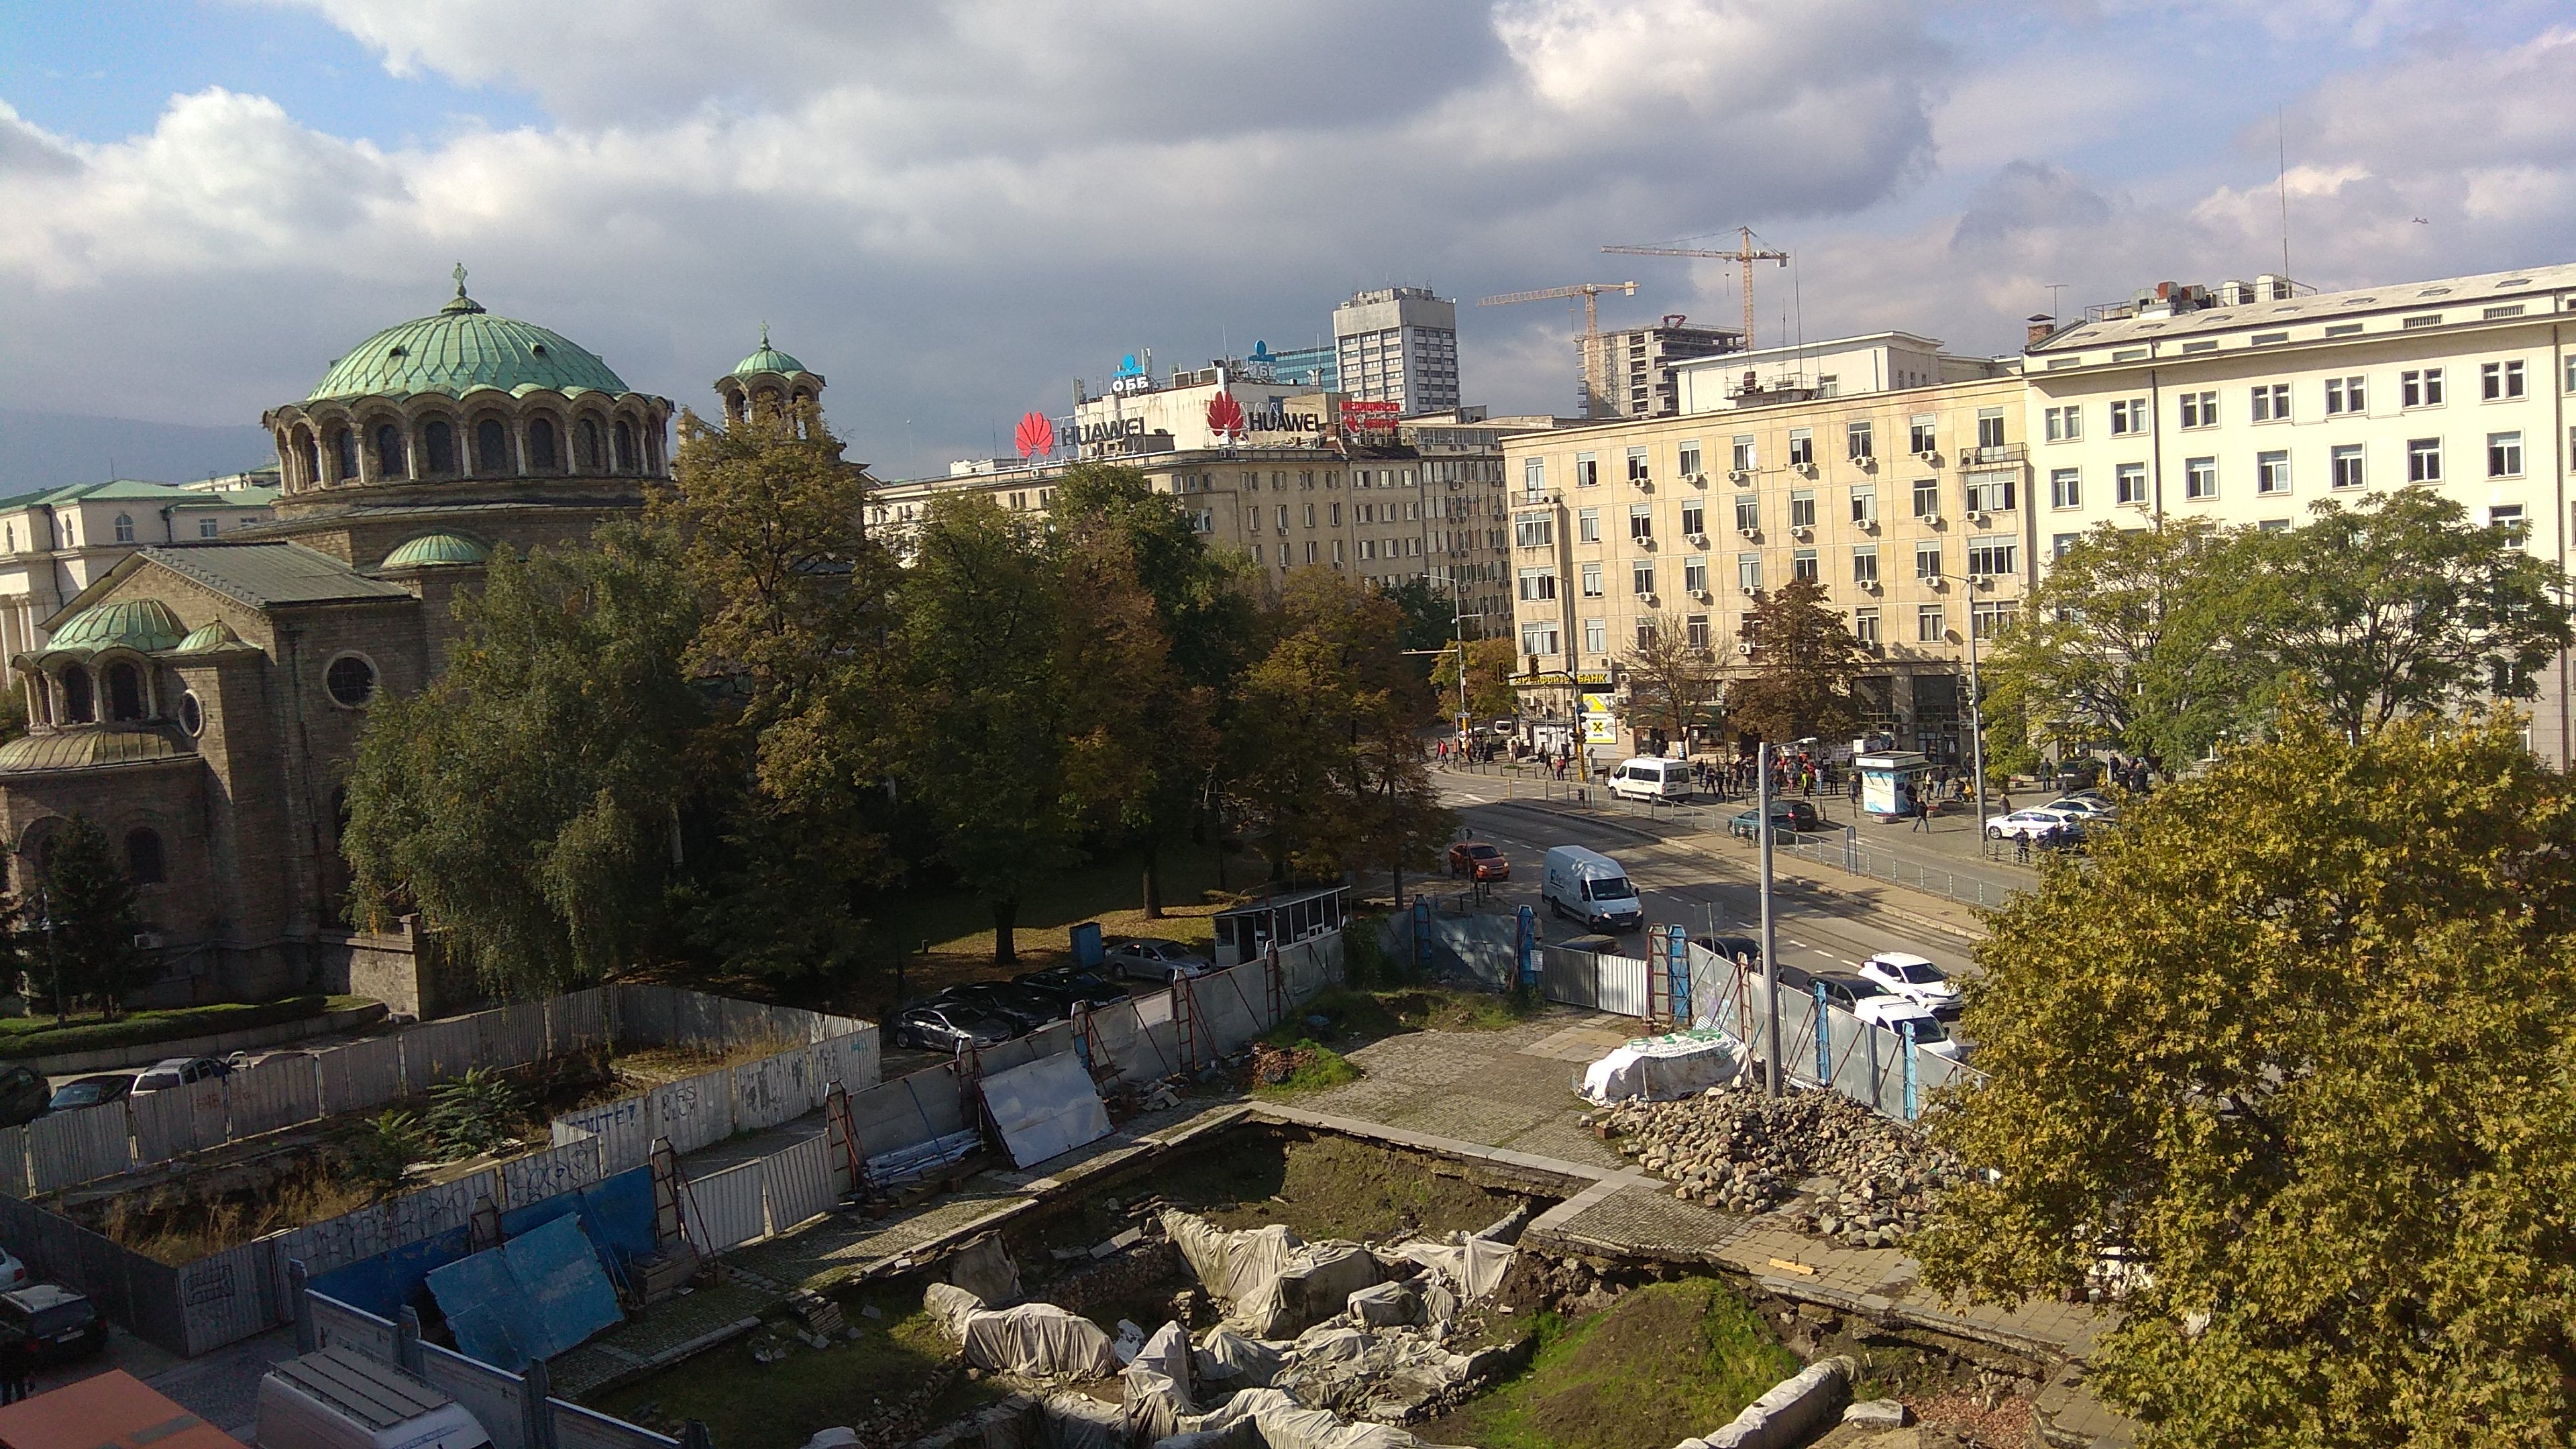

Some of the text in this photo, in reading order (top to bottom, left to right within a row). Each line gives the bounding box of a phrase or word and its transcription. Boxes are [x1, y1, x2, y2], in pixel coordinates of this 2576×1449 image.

[1112, 376, 1148, 392] ОББ
[1249, 412, 1320, 432] HUAWEI
[1061, 417, 1145, 447] HUAWEI
[1578, 674, 1607, 684] БАНК
